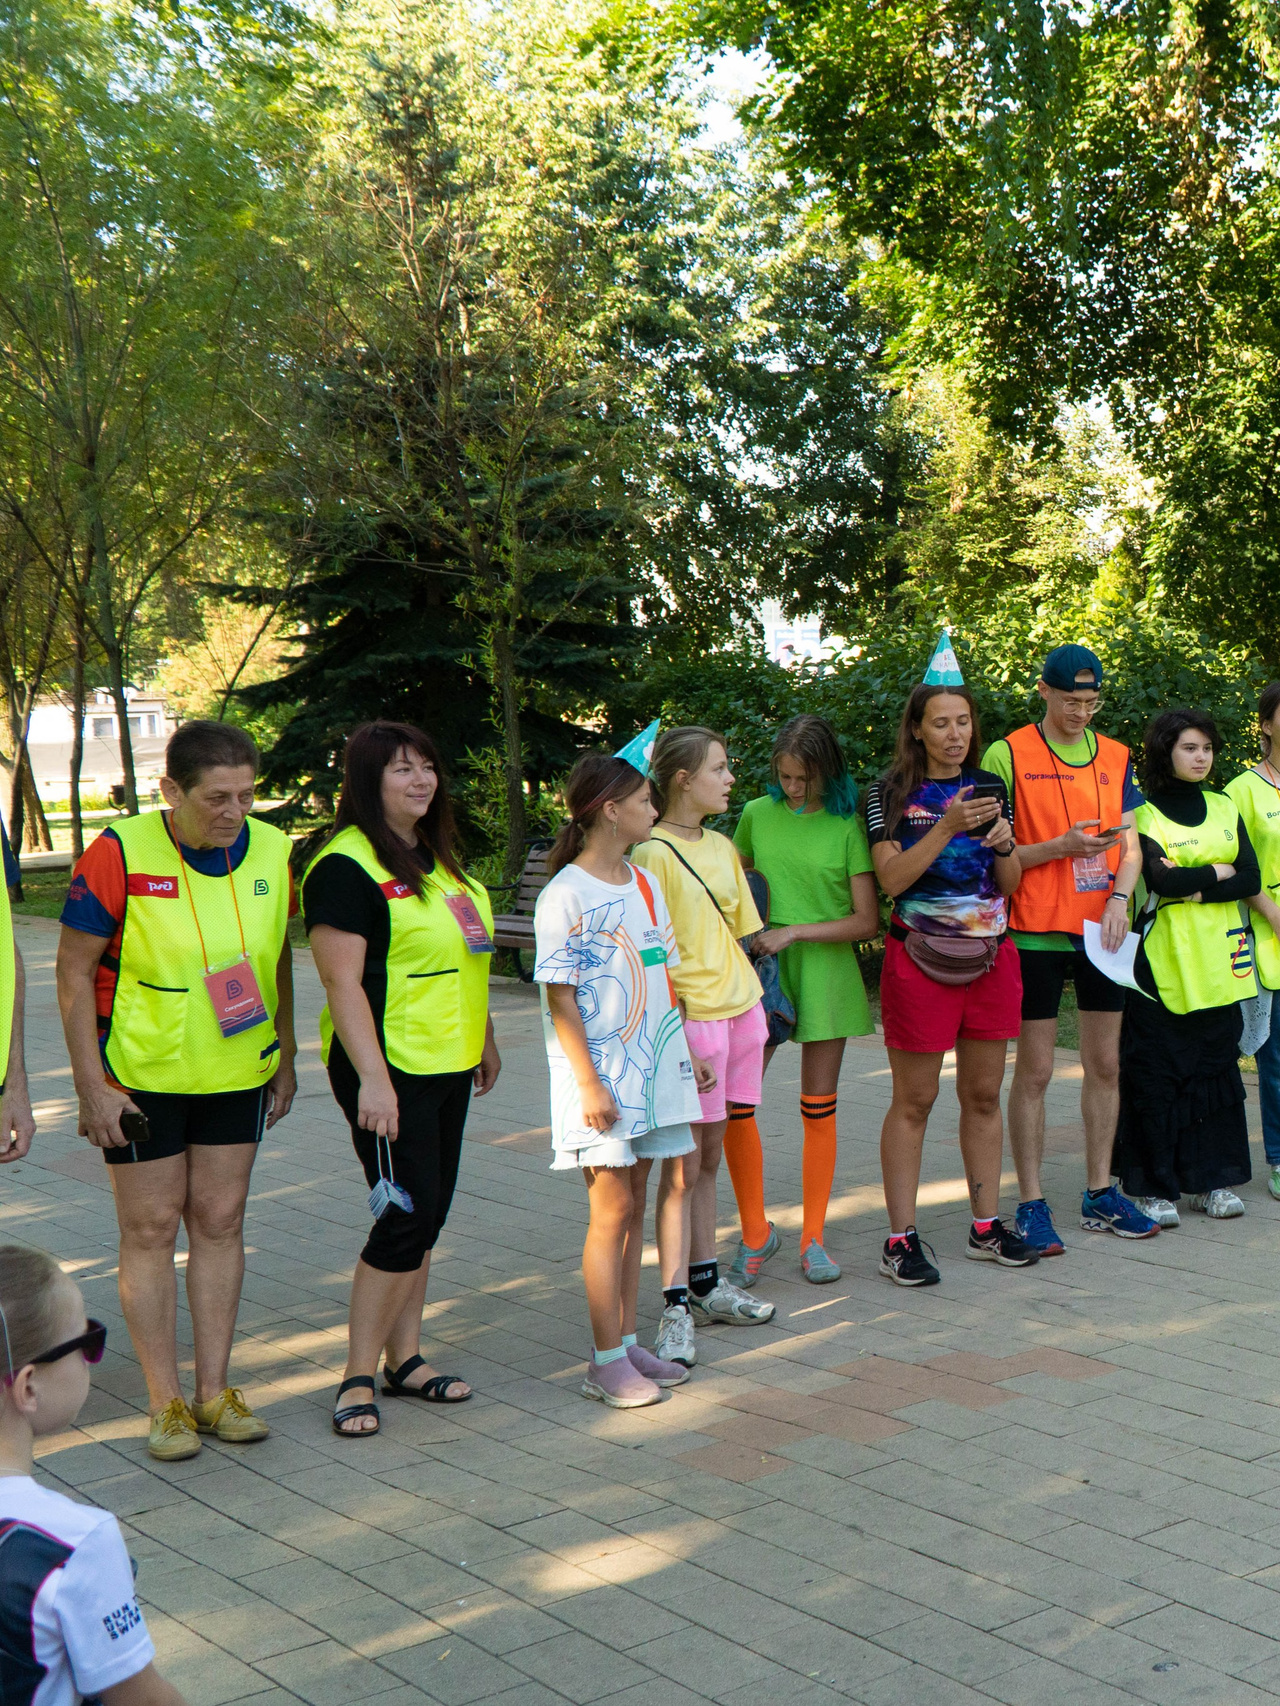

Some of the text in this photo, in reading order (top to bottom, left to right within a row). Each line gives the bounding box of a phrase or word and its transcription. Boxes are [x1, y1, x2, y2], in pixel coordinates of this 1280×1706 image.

[1167, 838, 1199, 848] олонтёр
[690, 1269, 713, 1282] SMILE
[103, 1603, 130, 1625] RUN
[106, 1605, 139, 1632] ULTRA
[110, 1613, 141, 1640] SWIM
